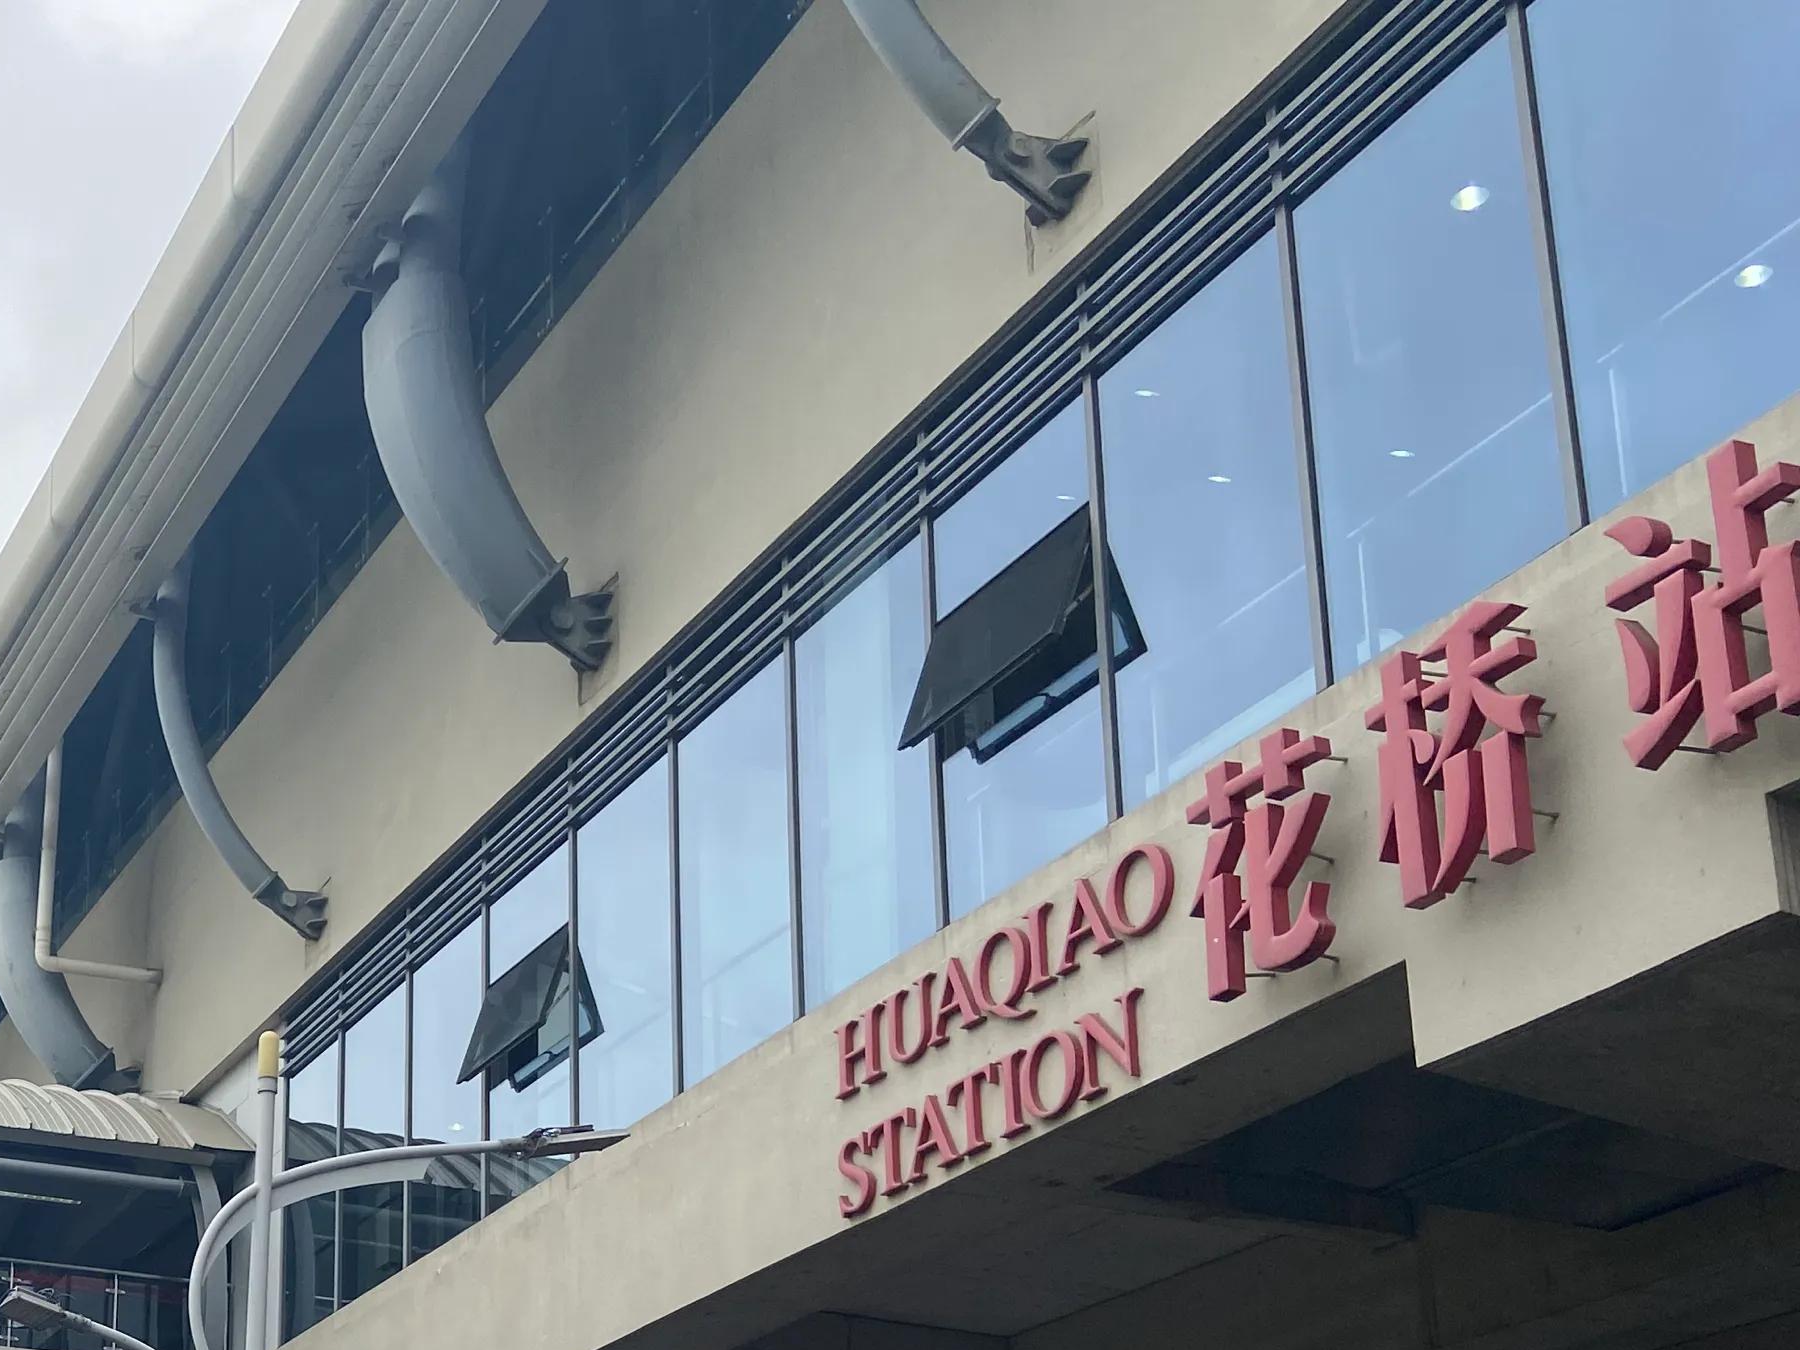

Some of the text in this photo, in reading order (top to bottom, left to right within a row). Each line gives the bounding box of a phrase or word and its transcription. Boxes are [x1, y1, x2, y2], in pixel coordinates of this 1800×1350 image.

[1187, 440, 1800, 1003] 花桥站
[835, 844, 1175, 1100] HUAQIAO
[839, 988, 1143, 1220] STATION
